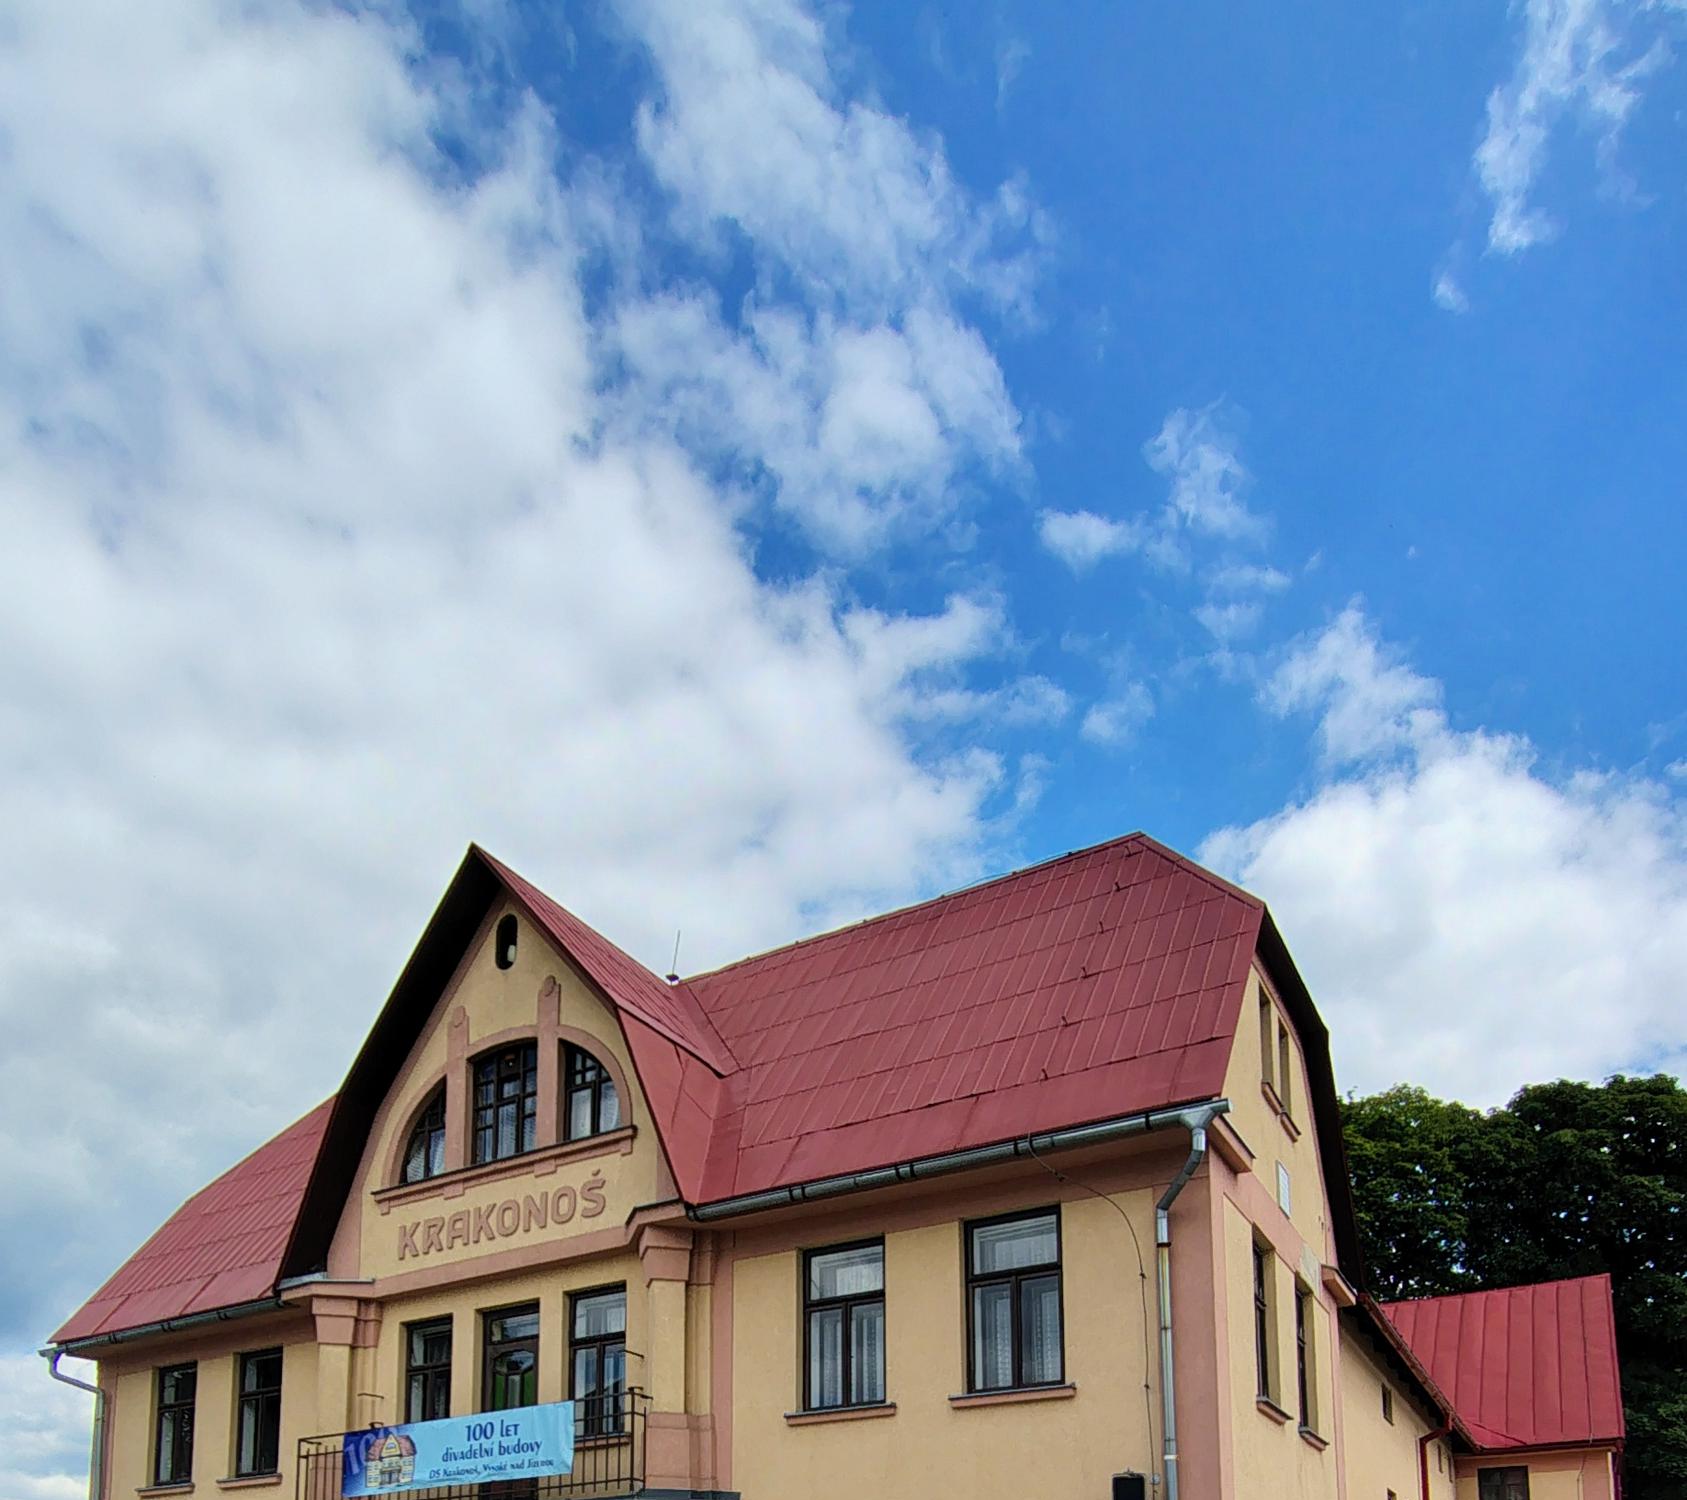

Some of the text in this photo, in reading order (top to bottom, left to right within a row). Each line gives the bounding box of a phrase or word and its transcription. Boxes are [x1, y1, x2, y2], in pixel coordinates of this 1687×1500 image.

[398, 1168, 607, 1261] KRAKONOŠ
[465, 1421, 494, 1442] 100
[498, 1438, 543, 1456] budovy
